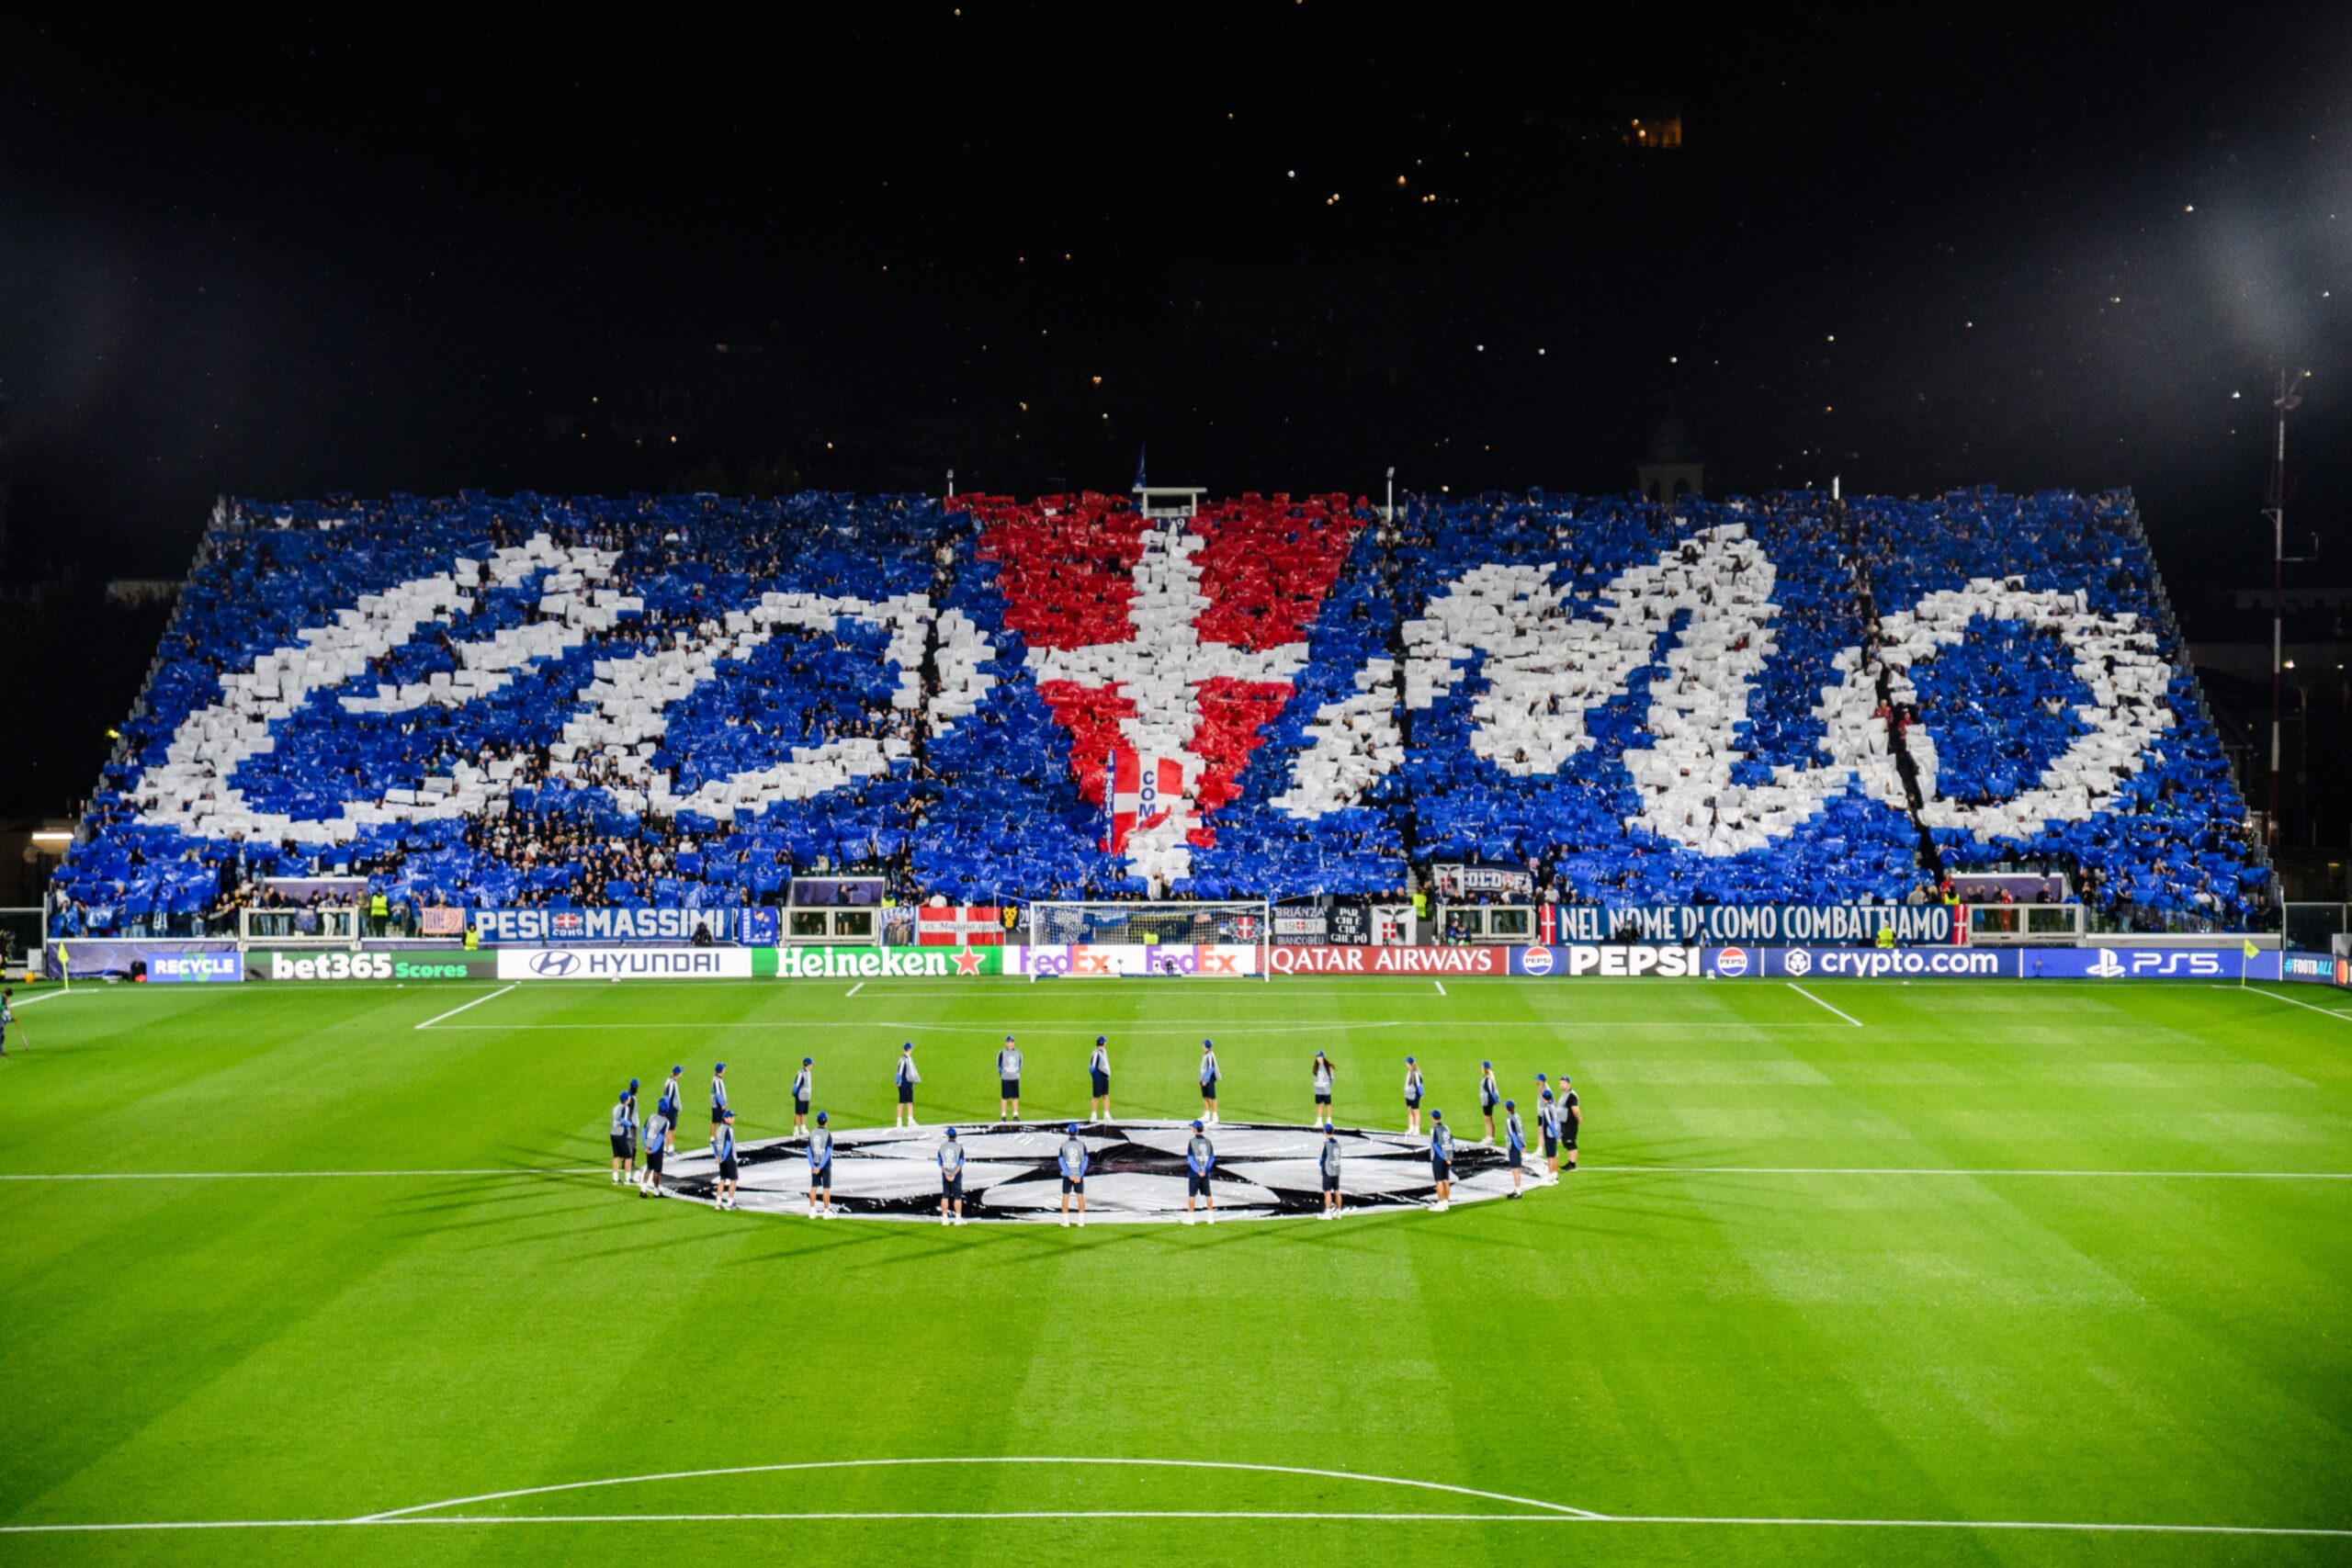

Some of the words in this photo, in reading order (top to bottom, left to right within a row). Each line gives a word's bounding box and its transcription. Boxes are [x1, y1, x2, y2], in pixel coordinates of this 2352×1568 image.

[475, 910, 548, 939] PESI
[552, 928, 583, 937] COMO
[585, 908, 724, 938] MASSIMI
[1276, 907, 1324, 918] BRIANZA
[1340, 908, 1359, 917] PAR
[1562, 908, 1604, 942] NEL
[1610, 908, 1677, 942] NOME
[1712, 906, 1779, 939] COMO
[1783, 906, 1949, 941] COMBATTIAMO
[1278, 935, 1324, 945] BIANCOBLU
[154, 959, 234, 975] RECYCLE
[273, 953, 391, 979] bet365
[396, 963, 468, 978] Scores
[590, 953, 720, 973] HYUNDAI
[776, 947, 947, 977] Heineken
[1020, 945, 1110, 974] FedEx
[1146, 945, 1237, 974] FedEx
[1272, 949, 1363, 975] QATAR
[1374, 949, 1492, 972] AIRWAYS
[1569, 946, 1700, 976] PEPSI
[1820, 951, 1998, 977] crypto.com
[2133, 953, 2219, 974] PS5
[2284, 958, 2333, 976] #FOOTBALL
